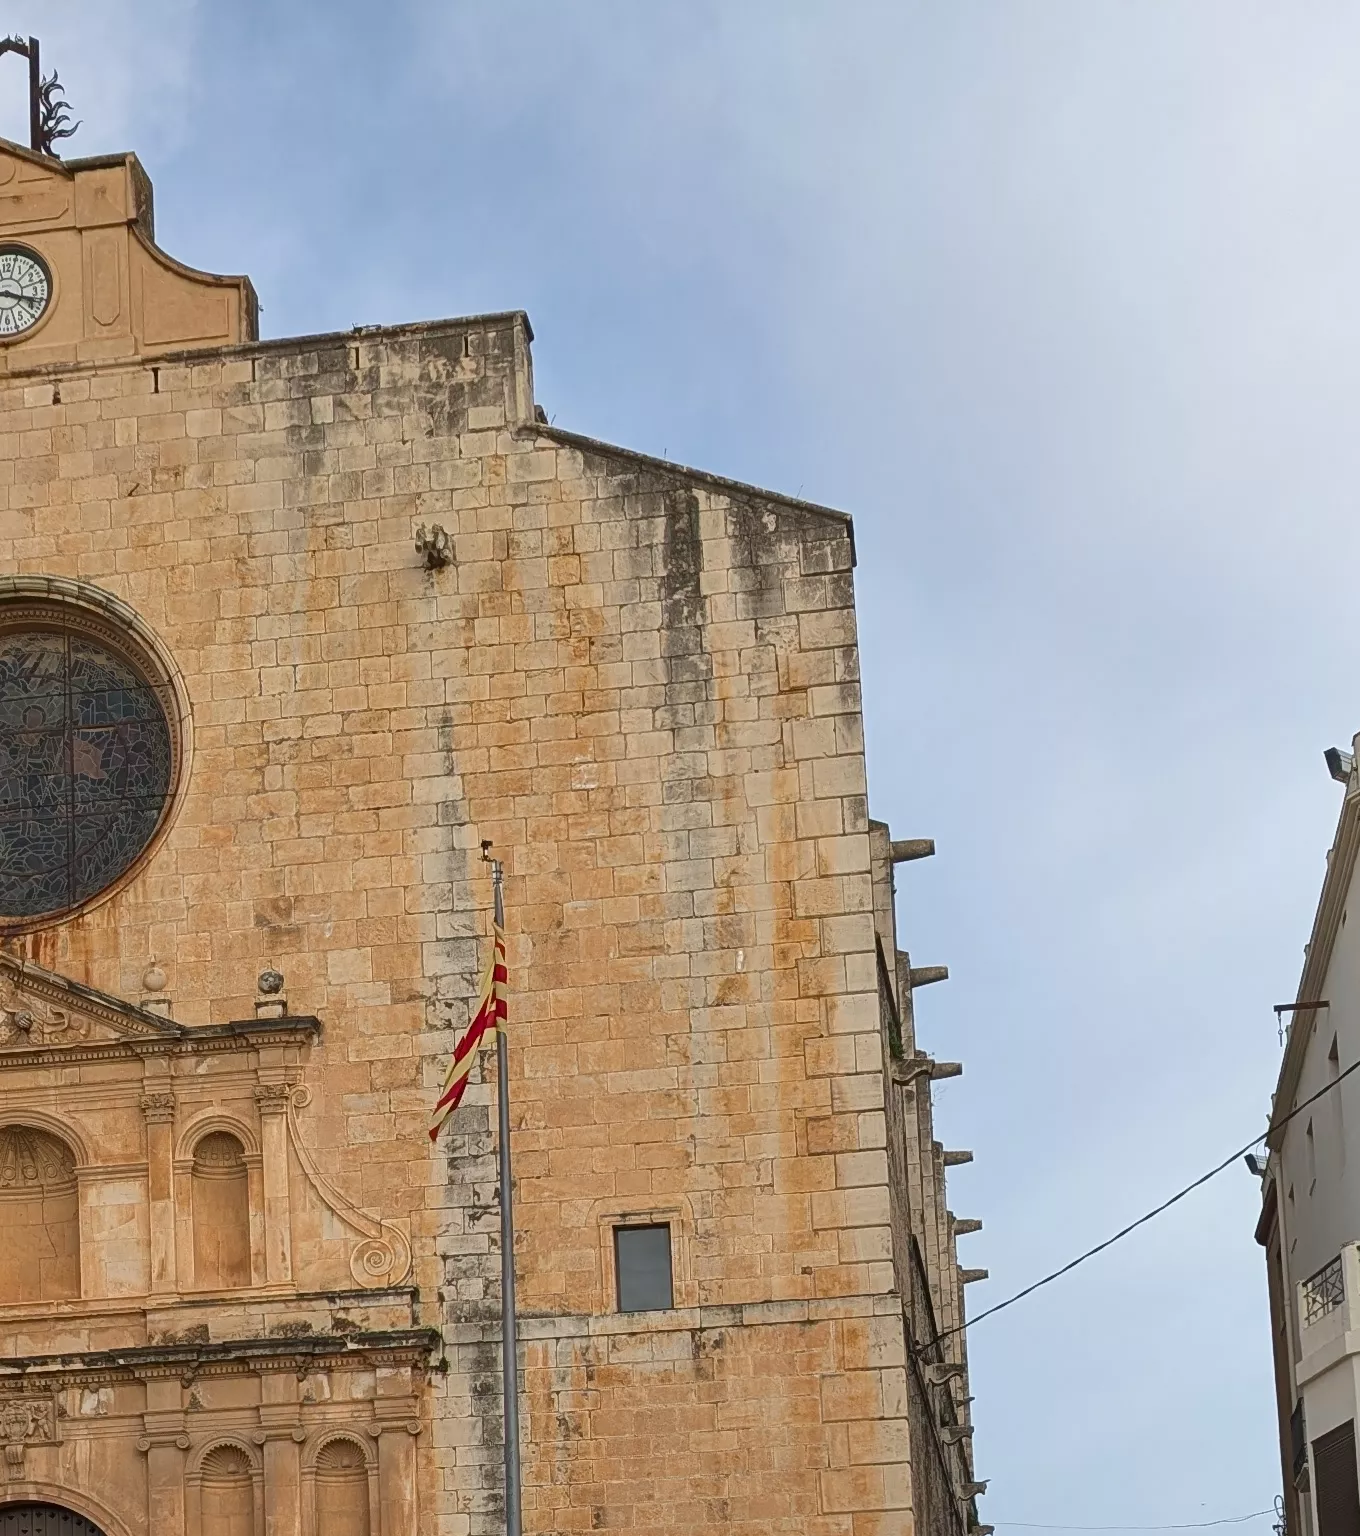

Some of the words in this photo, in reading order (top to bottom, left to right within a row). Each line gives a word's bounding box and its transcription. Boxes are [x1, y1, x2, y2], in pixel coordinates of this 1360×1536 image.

[2, 263, 11, 273] 12
[17, 265, 22, 274] 1
[28, 272, 34, 282] 2
[32, 286, 38, 297] 3
[5, 315, 10, 325] 6
[17, 311, 23, 321] 5
